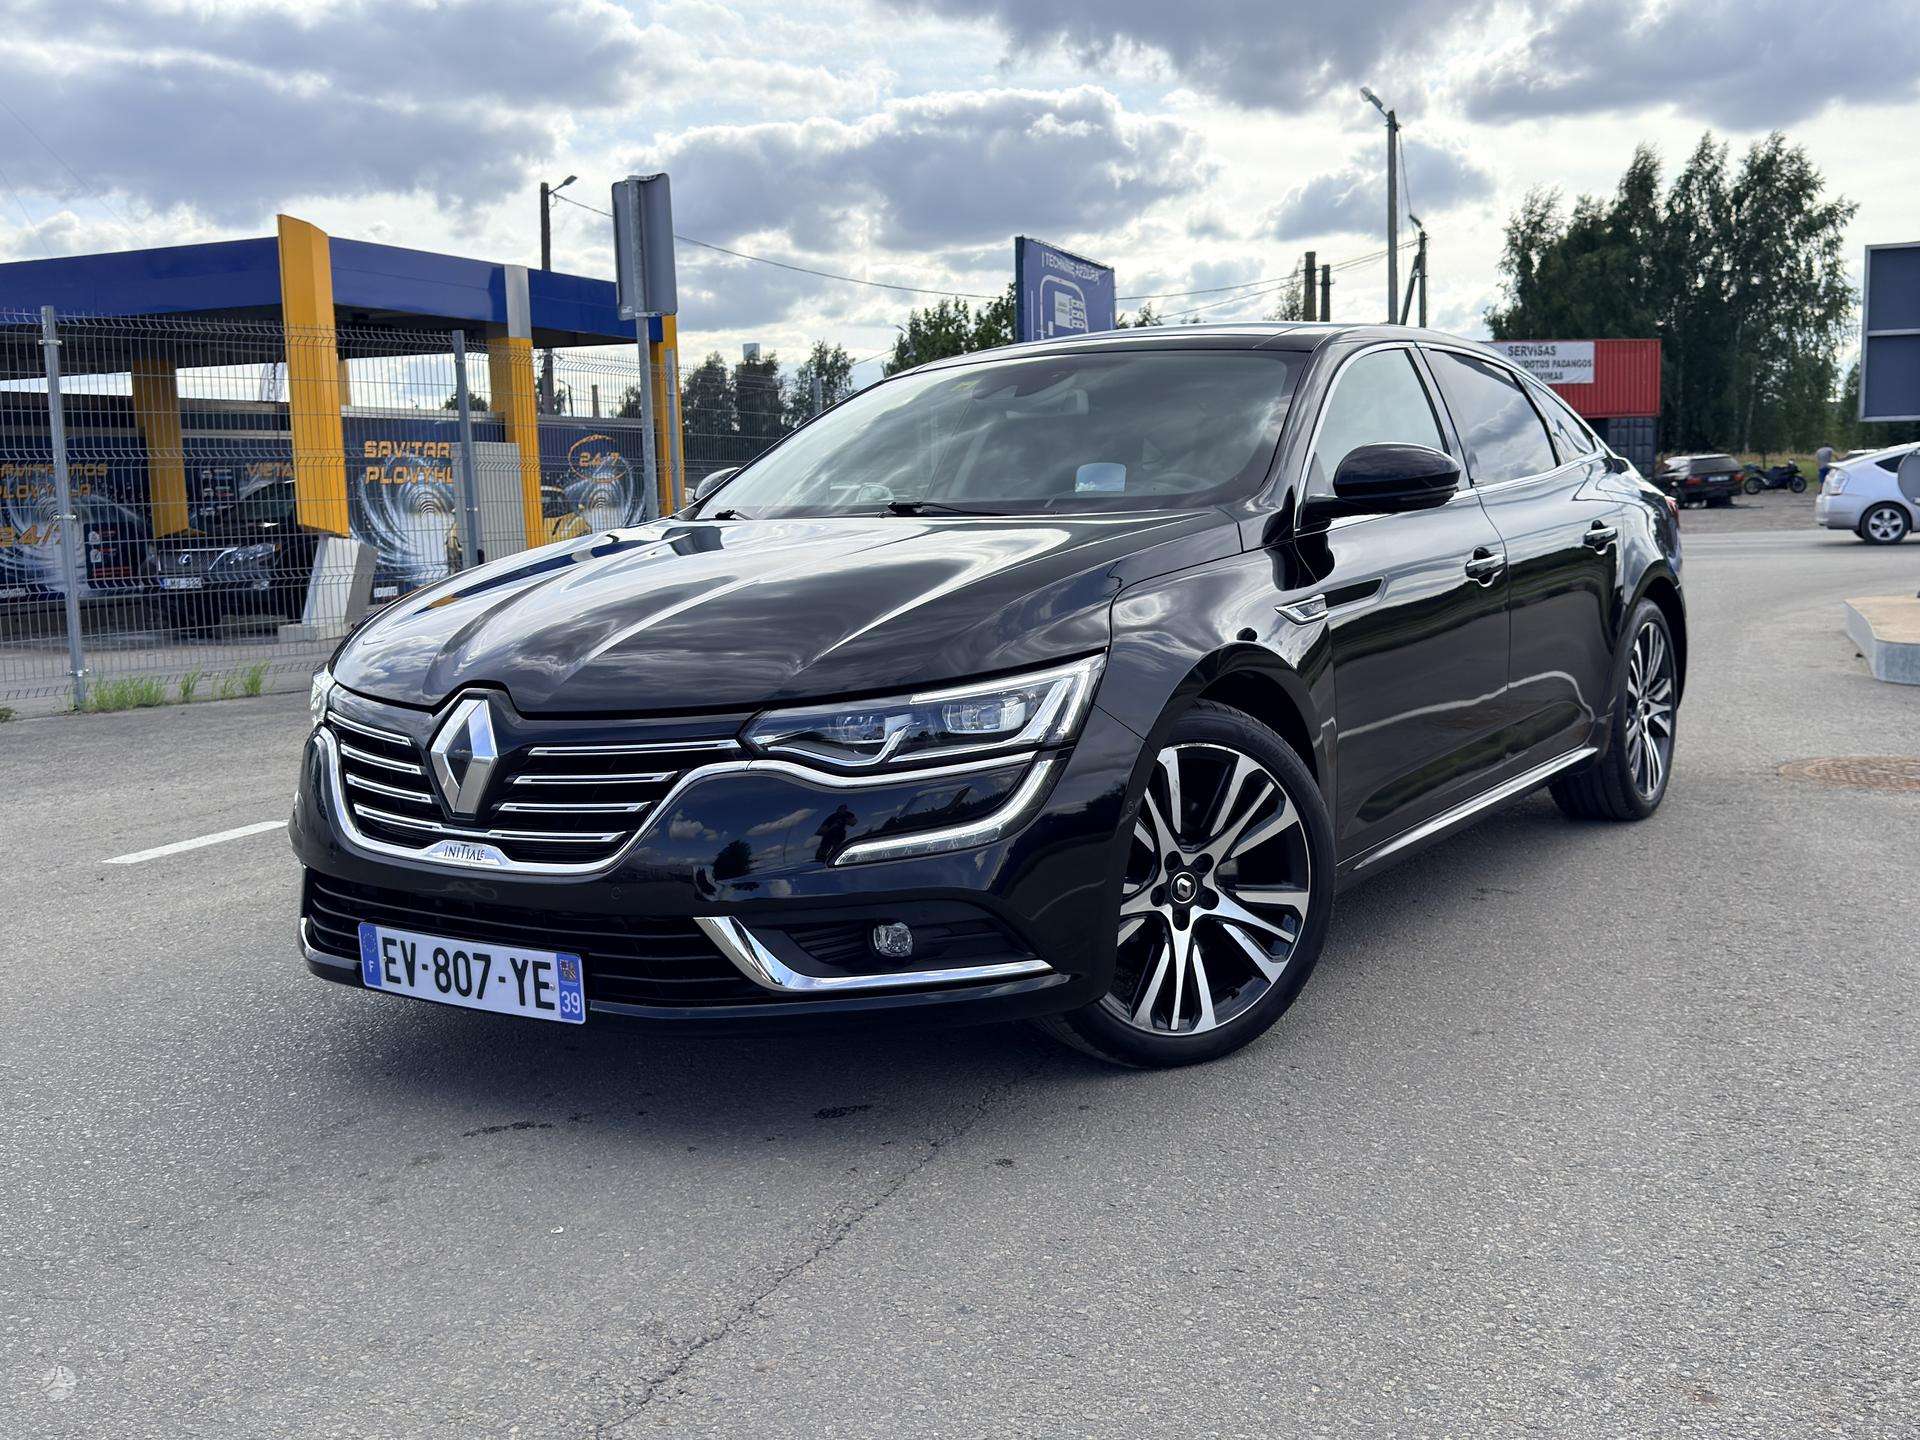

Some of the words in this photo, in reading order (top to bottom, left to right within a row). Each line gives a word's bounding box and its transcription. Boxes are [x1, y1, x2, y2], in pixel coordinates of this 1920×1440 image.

[1507, 345, 1557, 357] SERVISAS
[443, 844, 486, 862] INITIALE
[368, 960, 374, 974] F
[381, 936, 556, 1011] EV-807-YE
[560, 990, 582, 1015] 39
